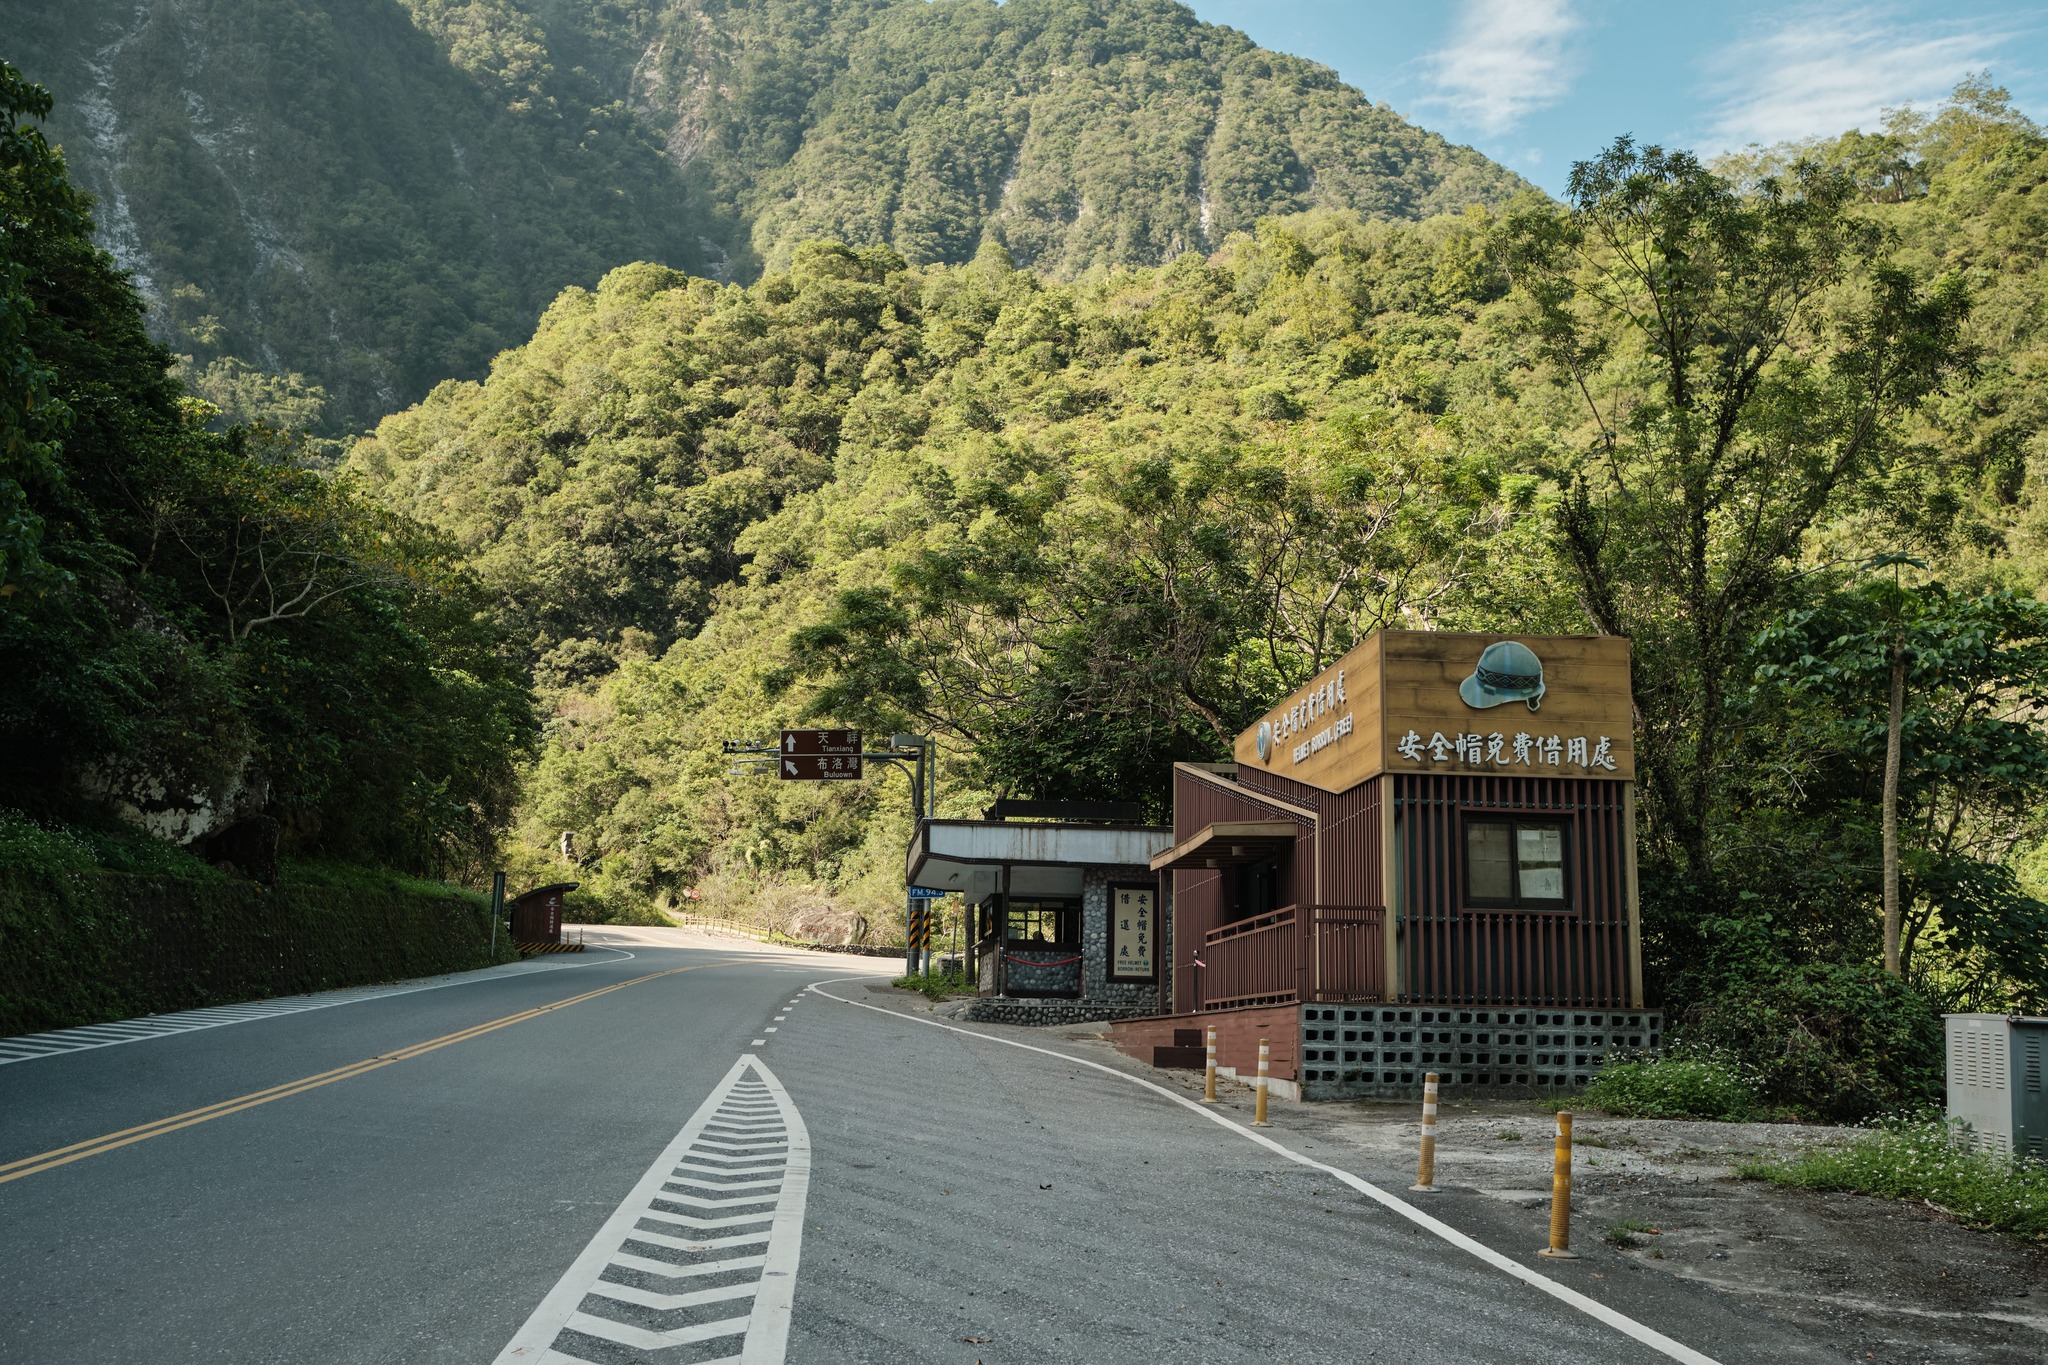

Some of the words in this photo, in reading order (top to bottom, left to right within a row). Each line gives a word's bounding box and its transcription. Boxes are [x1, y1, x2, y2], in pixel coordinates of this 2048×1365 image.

[1273, 670, 1347, 746] 安全帽免費借用處
[818, 732, 858, 744] 天祥
[822, 745, 854, 753] Tianxiang
[1397, 729, 1618, 771] 安全帽免費借用處
[817, 757, 858, 770] 布洛灣
[1137, 893, 1148, 957] 安全帽免費
